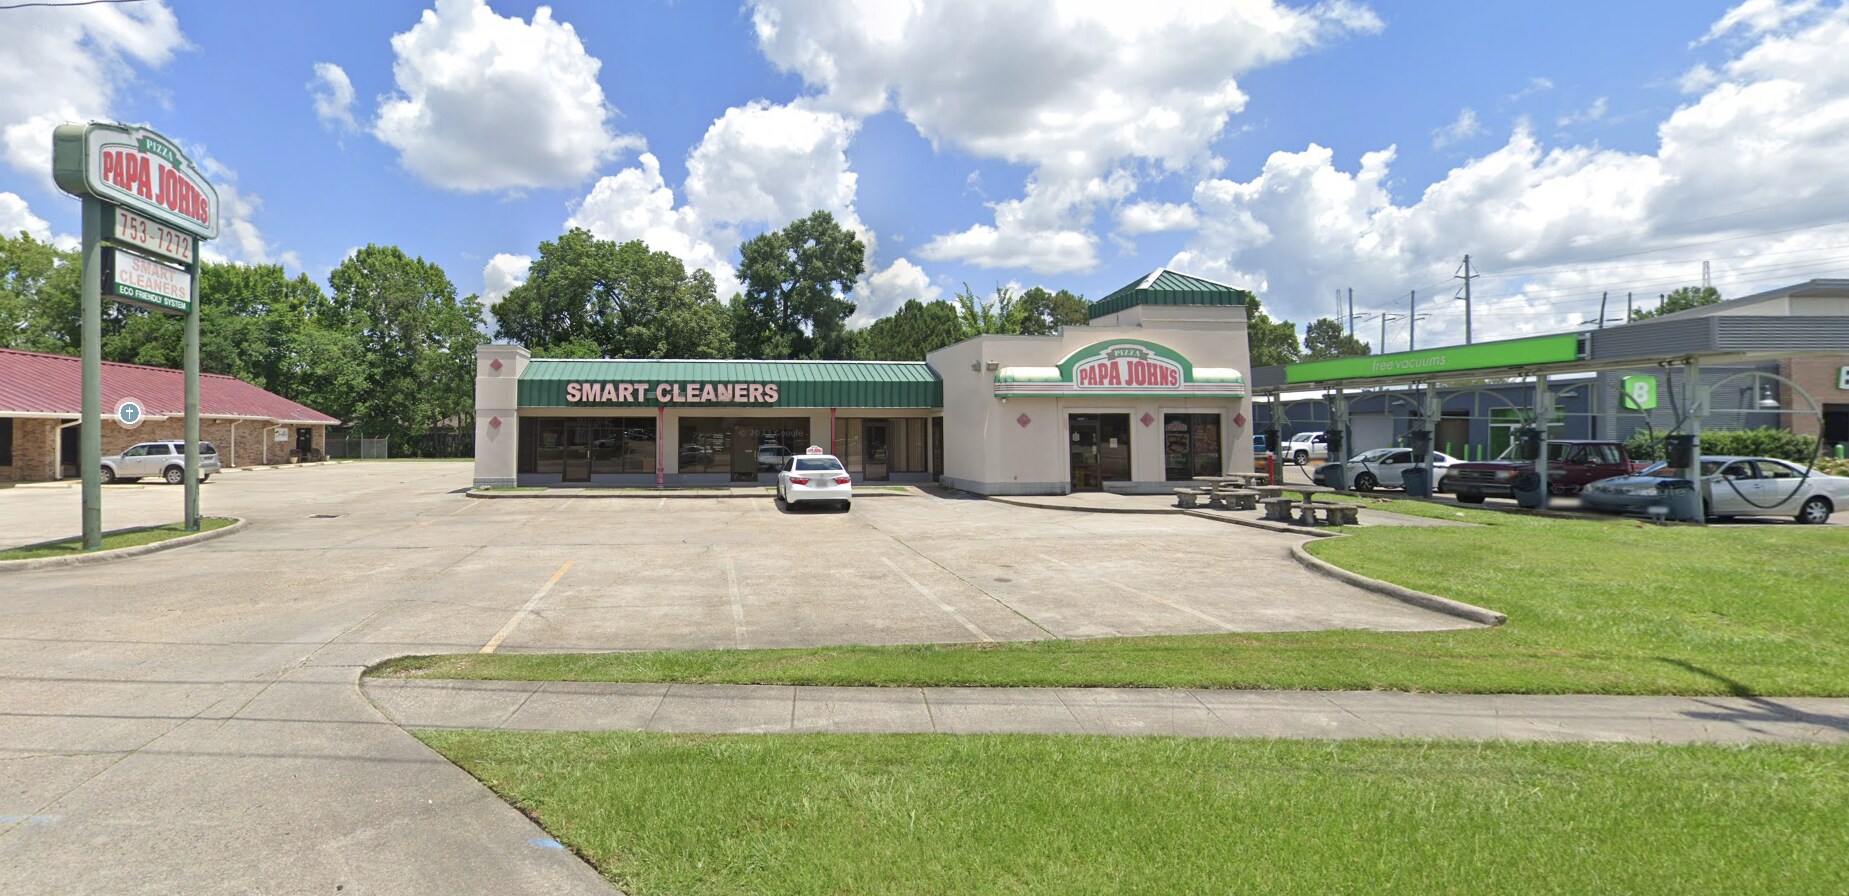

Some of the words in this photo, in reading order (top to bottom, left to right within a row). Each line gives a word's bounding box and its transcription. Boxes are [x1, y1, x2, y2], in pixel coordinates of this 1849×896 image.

[145, 138, 174, 162] PIZZA
[103, 151, 153, 200] PAPA
[121, 212, 188, 259] 753-7272
[133, 257, 177, 282] SMART
[120, 268, 185, 298] CLEANERS
[119, 285, 134, 296] ECO
[135, 289, 163, 303] FRIENDLY
[164, 297, 187, 309] SYSTEM
[1114, 349, 1141, 357] PIZZA
[1372, 359, 1393, 372] free
[1395, 355, 1446, 369] vacuums
[1079, 361, 1122, 386] PAPA
[566, 382, 649, 402] SMART
[656, 383, 779, 403] CLEANERS
[1632, 381, 1649, 403] B
